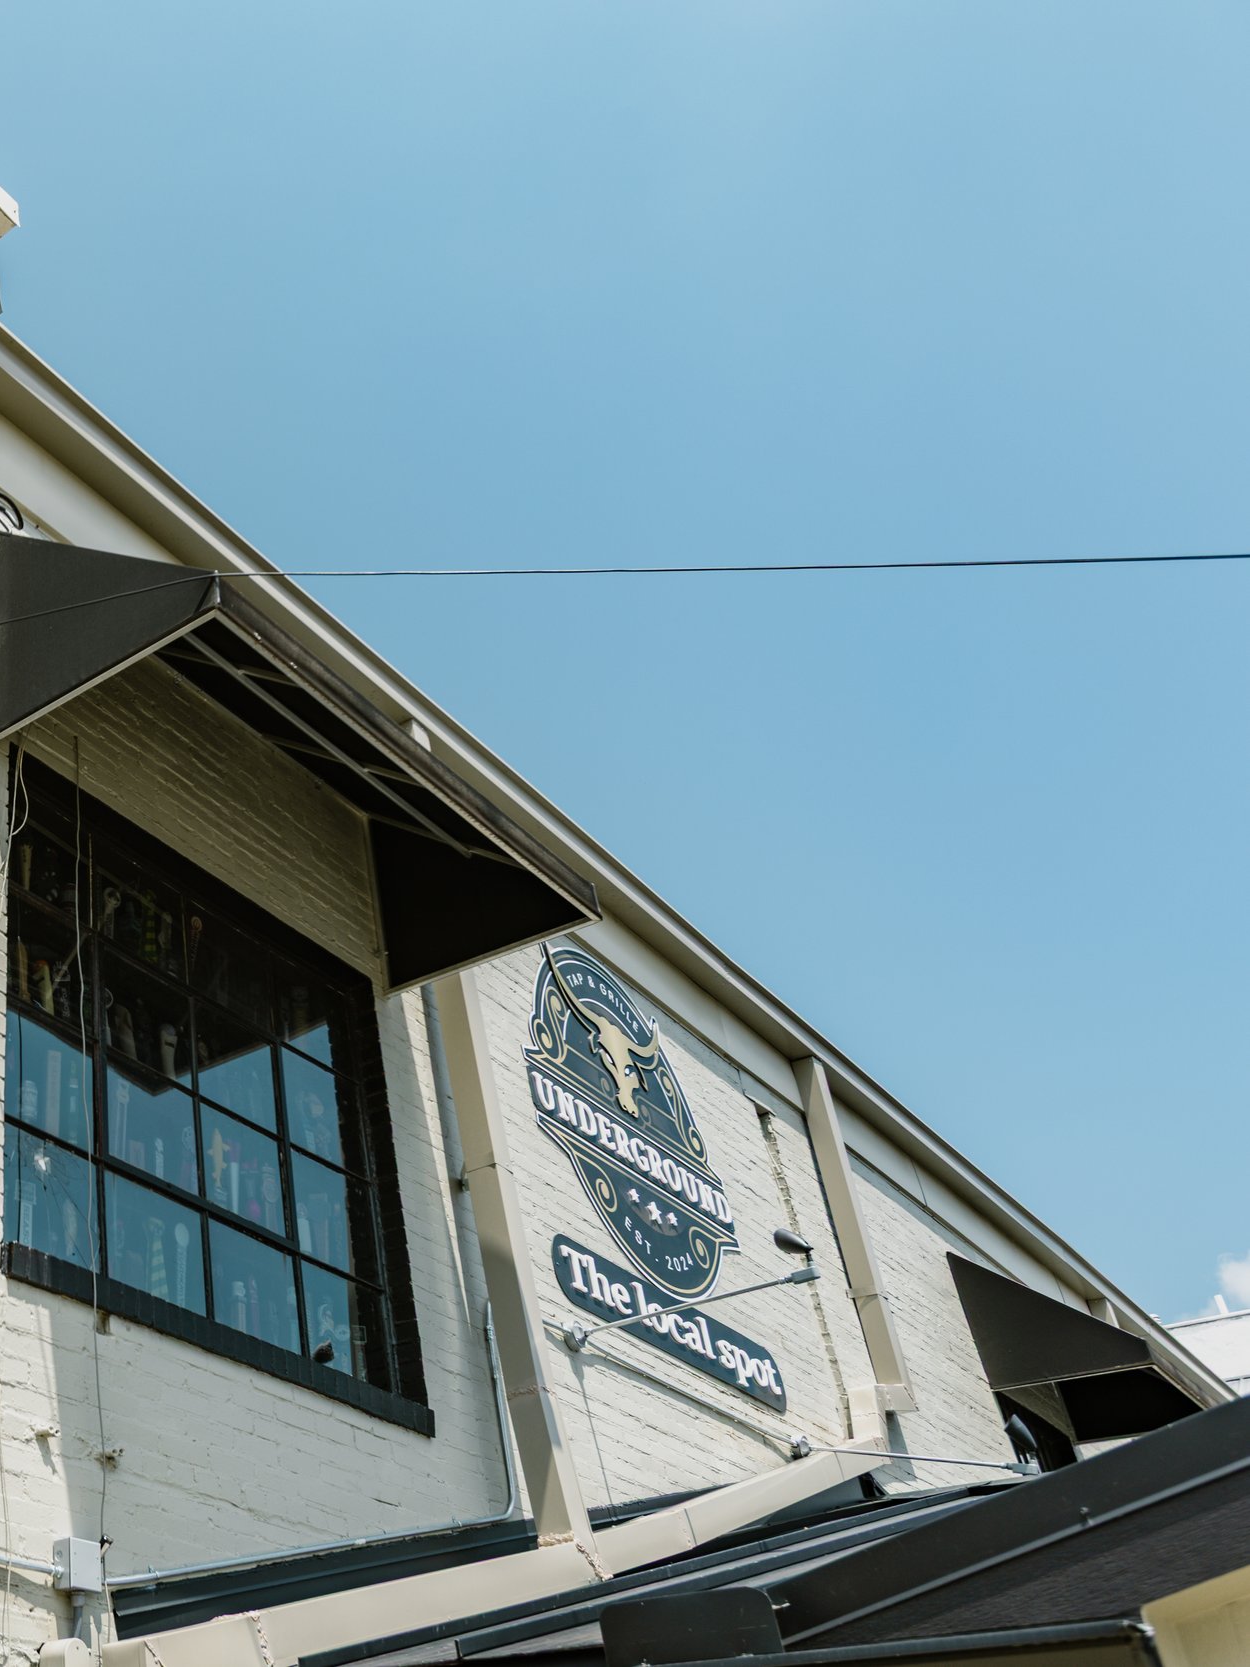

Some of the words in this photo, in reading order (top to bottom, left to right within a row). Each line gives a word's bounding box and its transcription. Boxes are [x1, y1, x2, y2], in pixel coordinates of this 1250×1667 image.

[566, 973, 584, 988] TAP
[587, 975, 596, 989] &
[599, 983, 639, 1033] GRILLE
[531, 1071, 732, 1224] UNDERGROUND
[665, 1252, 694, 1272] 2024
[559, 1244, 633, 1316] The
[630, 1281, 717, 1361] local
[715, 1339, 782, 1396] spot
